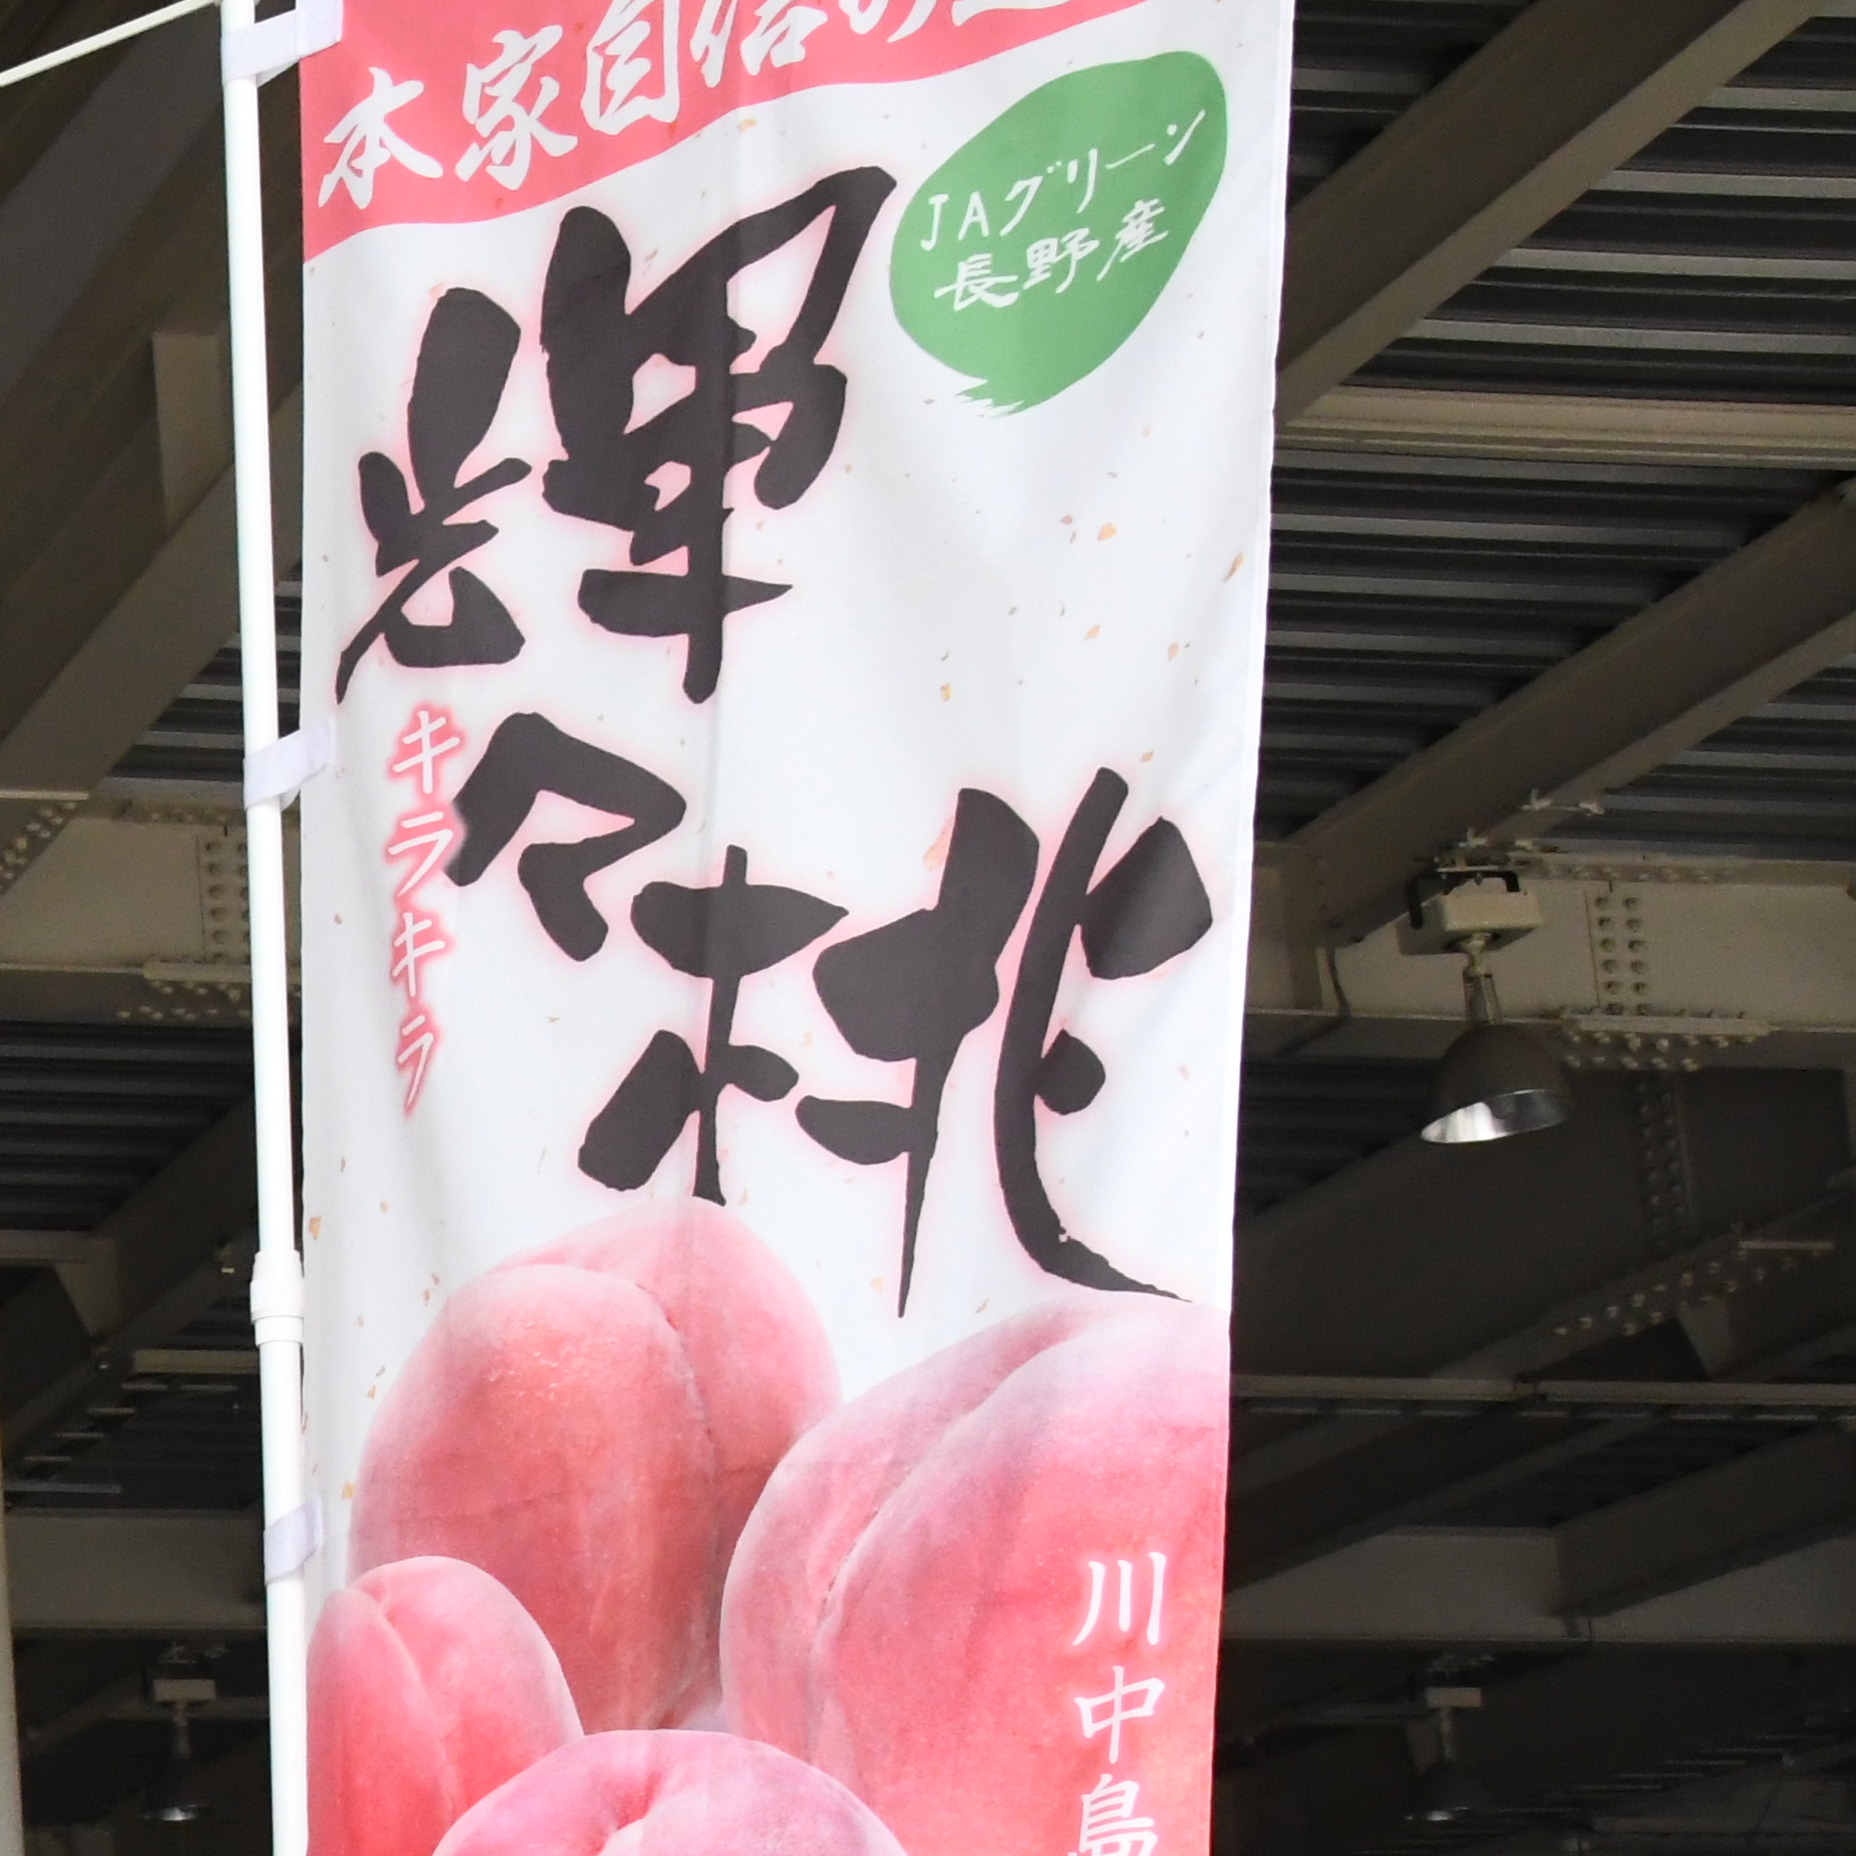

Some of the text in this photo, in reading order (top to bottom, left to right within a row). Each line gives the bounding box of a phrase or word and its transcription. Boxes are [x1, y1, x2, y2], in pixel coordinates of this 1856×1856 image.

[920, 108, 1205, 251] JAグリーン
[934, 197, 1169, 312] 長野産
[390, 708, 462, 1112] キラキラ
